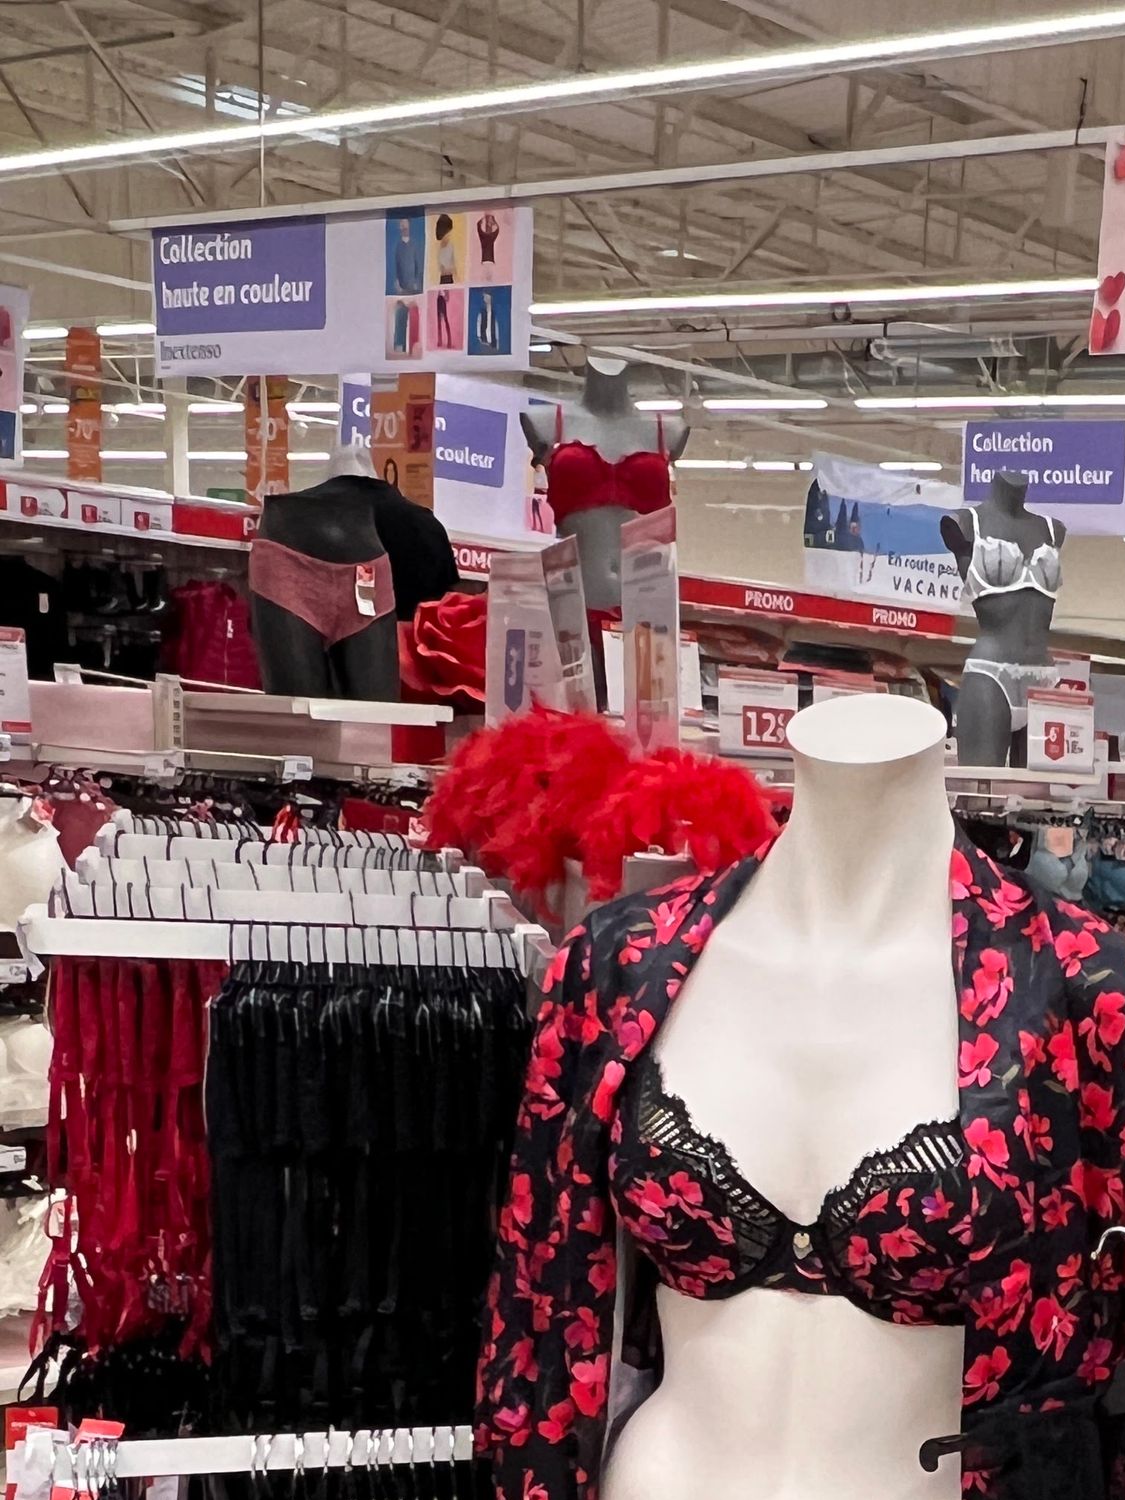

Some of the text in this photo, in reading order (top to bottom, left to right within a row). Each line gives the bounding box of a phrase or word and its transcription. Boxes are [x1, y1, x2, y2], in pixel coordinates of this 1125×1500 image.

[160, 232, 252, 265] Collection
[162, 273, 313, 309] haute en couleur
[972, 432, 1053, 453] Collection
[435, 446, 495, 470] couleur
[1043, 464, 1114, 485] couleur
[887, 551, 958, 578] En route pou
[744, 590, 794, 612] PROMO
[893, 577, 962, 601] VACANC
[872, 608, 917, 628] PROMO
